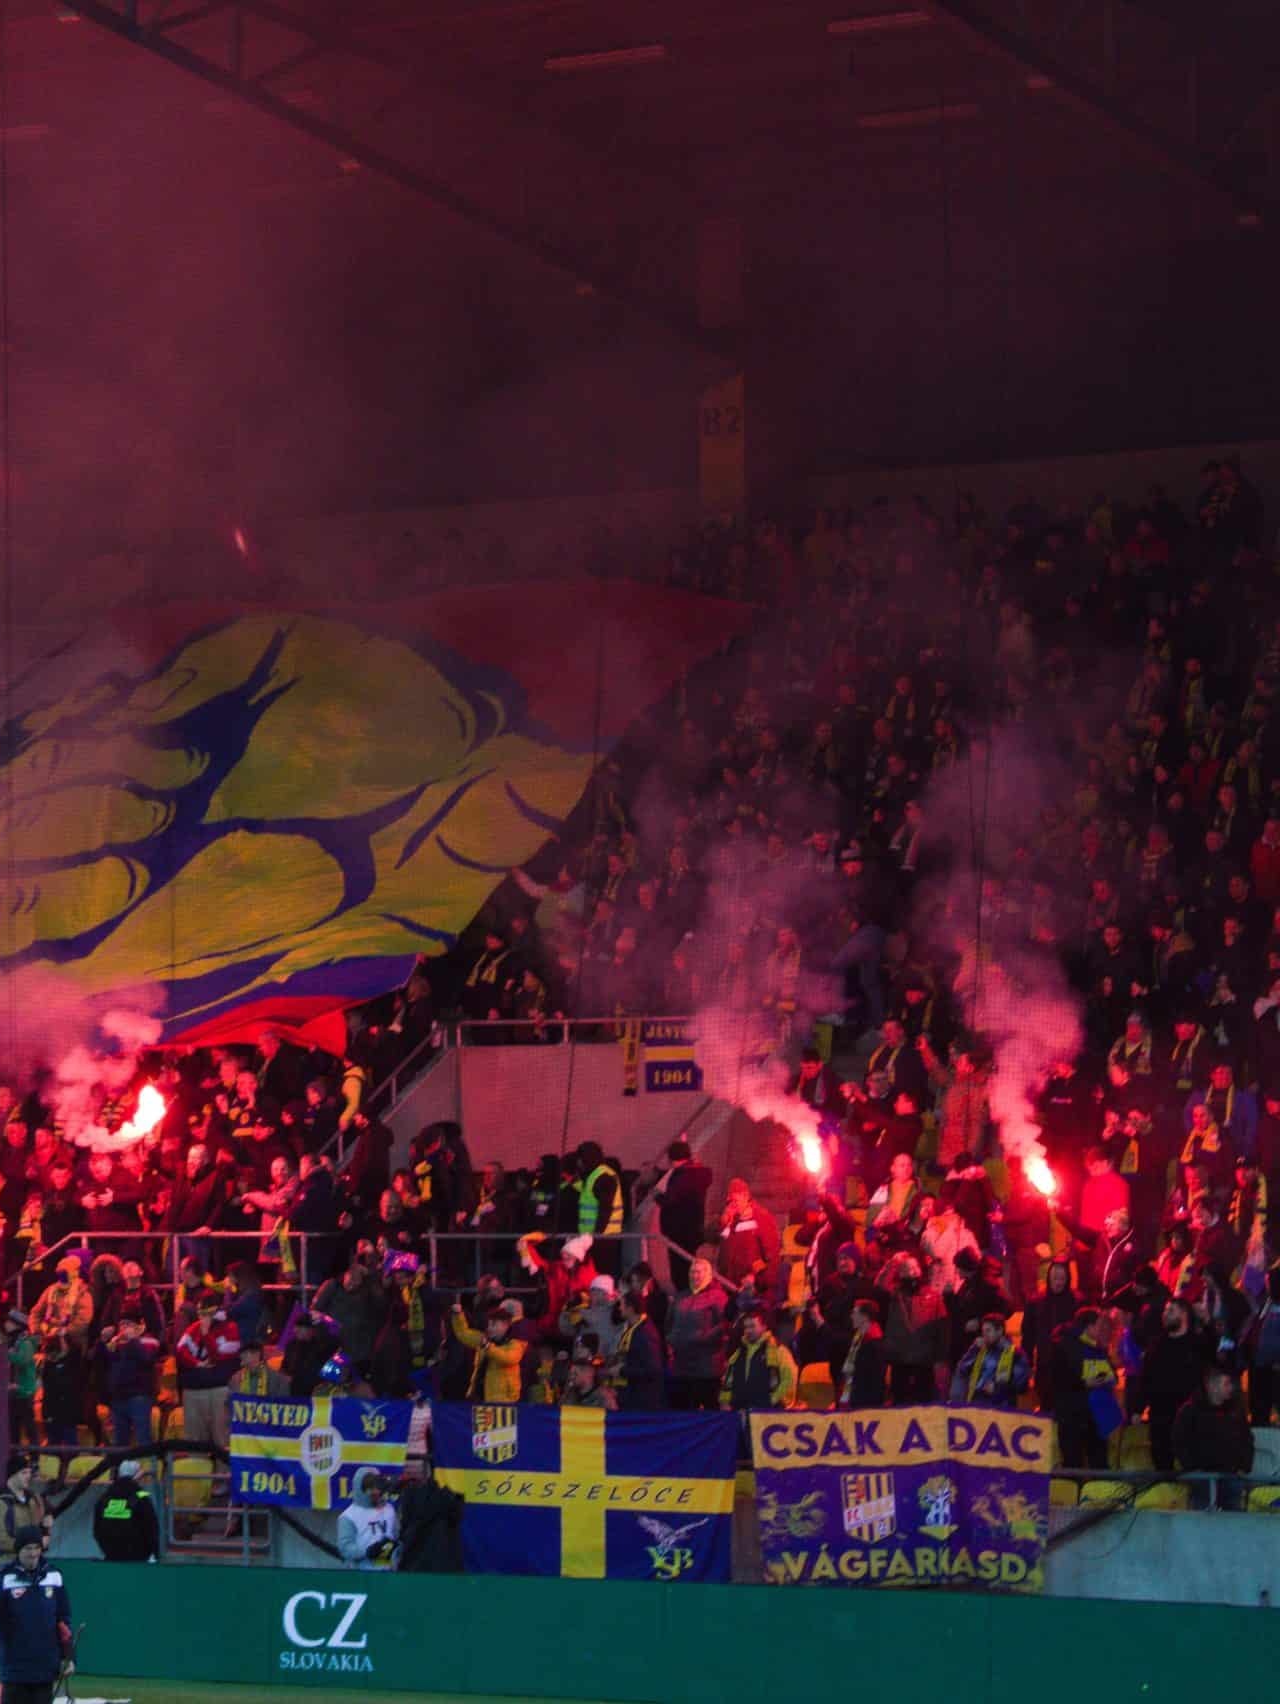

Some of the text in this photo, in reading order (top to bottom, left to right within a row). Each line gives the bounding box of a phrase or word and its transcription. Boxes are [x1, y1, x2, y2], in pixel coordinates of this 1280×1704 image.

[232, 1401, 310, 1427] NEGYED
[760, 1417, 1043, 1460] CSAK A DAC
[239, 1470, 296, 1496] 1904
[475, 1475, 696, 1504] SÓKSZELŐCE
[781, 1543, 1027, 1582] VÁGFARKASD
[283, 1590, 368, 1648] CZ
[279, 1651, 375, 1672] SLOVAKIA
